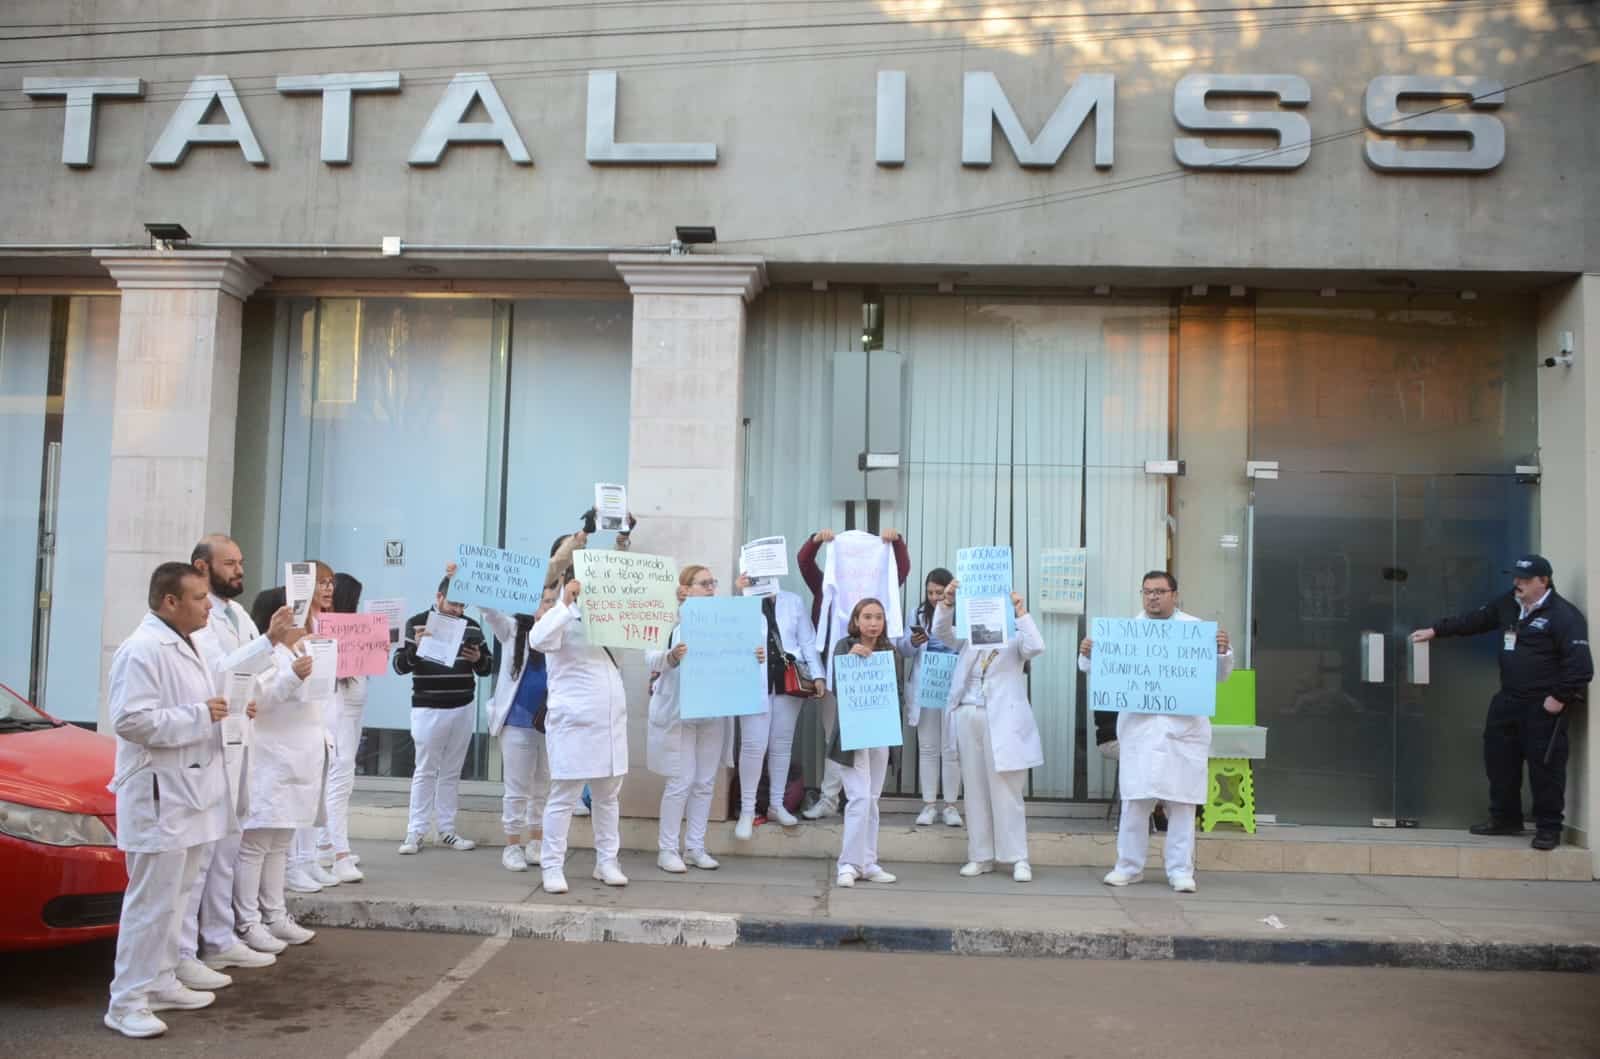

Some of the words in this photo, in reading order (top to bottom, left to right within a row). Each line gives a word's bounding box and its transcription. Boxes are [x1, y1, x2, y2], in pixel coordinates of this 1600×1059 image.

[22, 70, 718, 167] TATAL
[875, 71, 1507, 172] IMSS
[502, 552, 541, 568] MEDICOS
[584, 552, 599, 563] No
[606, 554, 634, 569] tengo
[636, 557, 664, 569] miedo
[585, 566, 597, 578] de
[617, 569, 644, 584] tengo
[649, 570, 674, 582] miedo
[585, 583, 598, 594] de
[603, 585, 616, 593] no
[621, 583, 648, 595] volver
[589, 613, 614, 624] PARA
[619, 611, 674, 623] RESIDENTES
[1098, 620, 1110, 639] SI
[1120, 621, 1172, 639] SALVAR
[1183, 624, 1201, 639] LA
[924, 654, 940, 665] NO
[1097, 641, 1121, 656] VIDA
[1125, 643, 1137, 657] DE
[1146, 644, 1168, 659] LOS
[1178, 646, 1213, 661] DEMAS
[1100, 661, 1151, 677] SIGNIFICA
[1160, 664, 1198, 679] PERDER
[1127, 680, 1138, 692] LA
[1145, 681, 1161, 692] MIA
[1093, 691, 1110, 706] NO
[1116, 692, 1128, 708] ES
[1137, 694, 1177, 711] JUSTO
